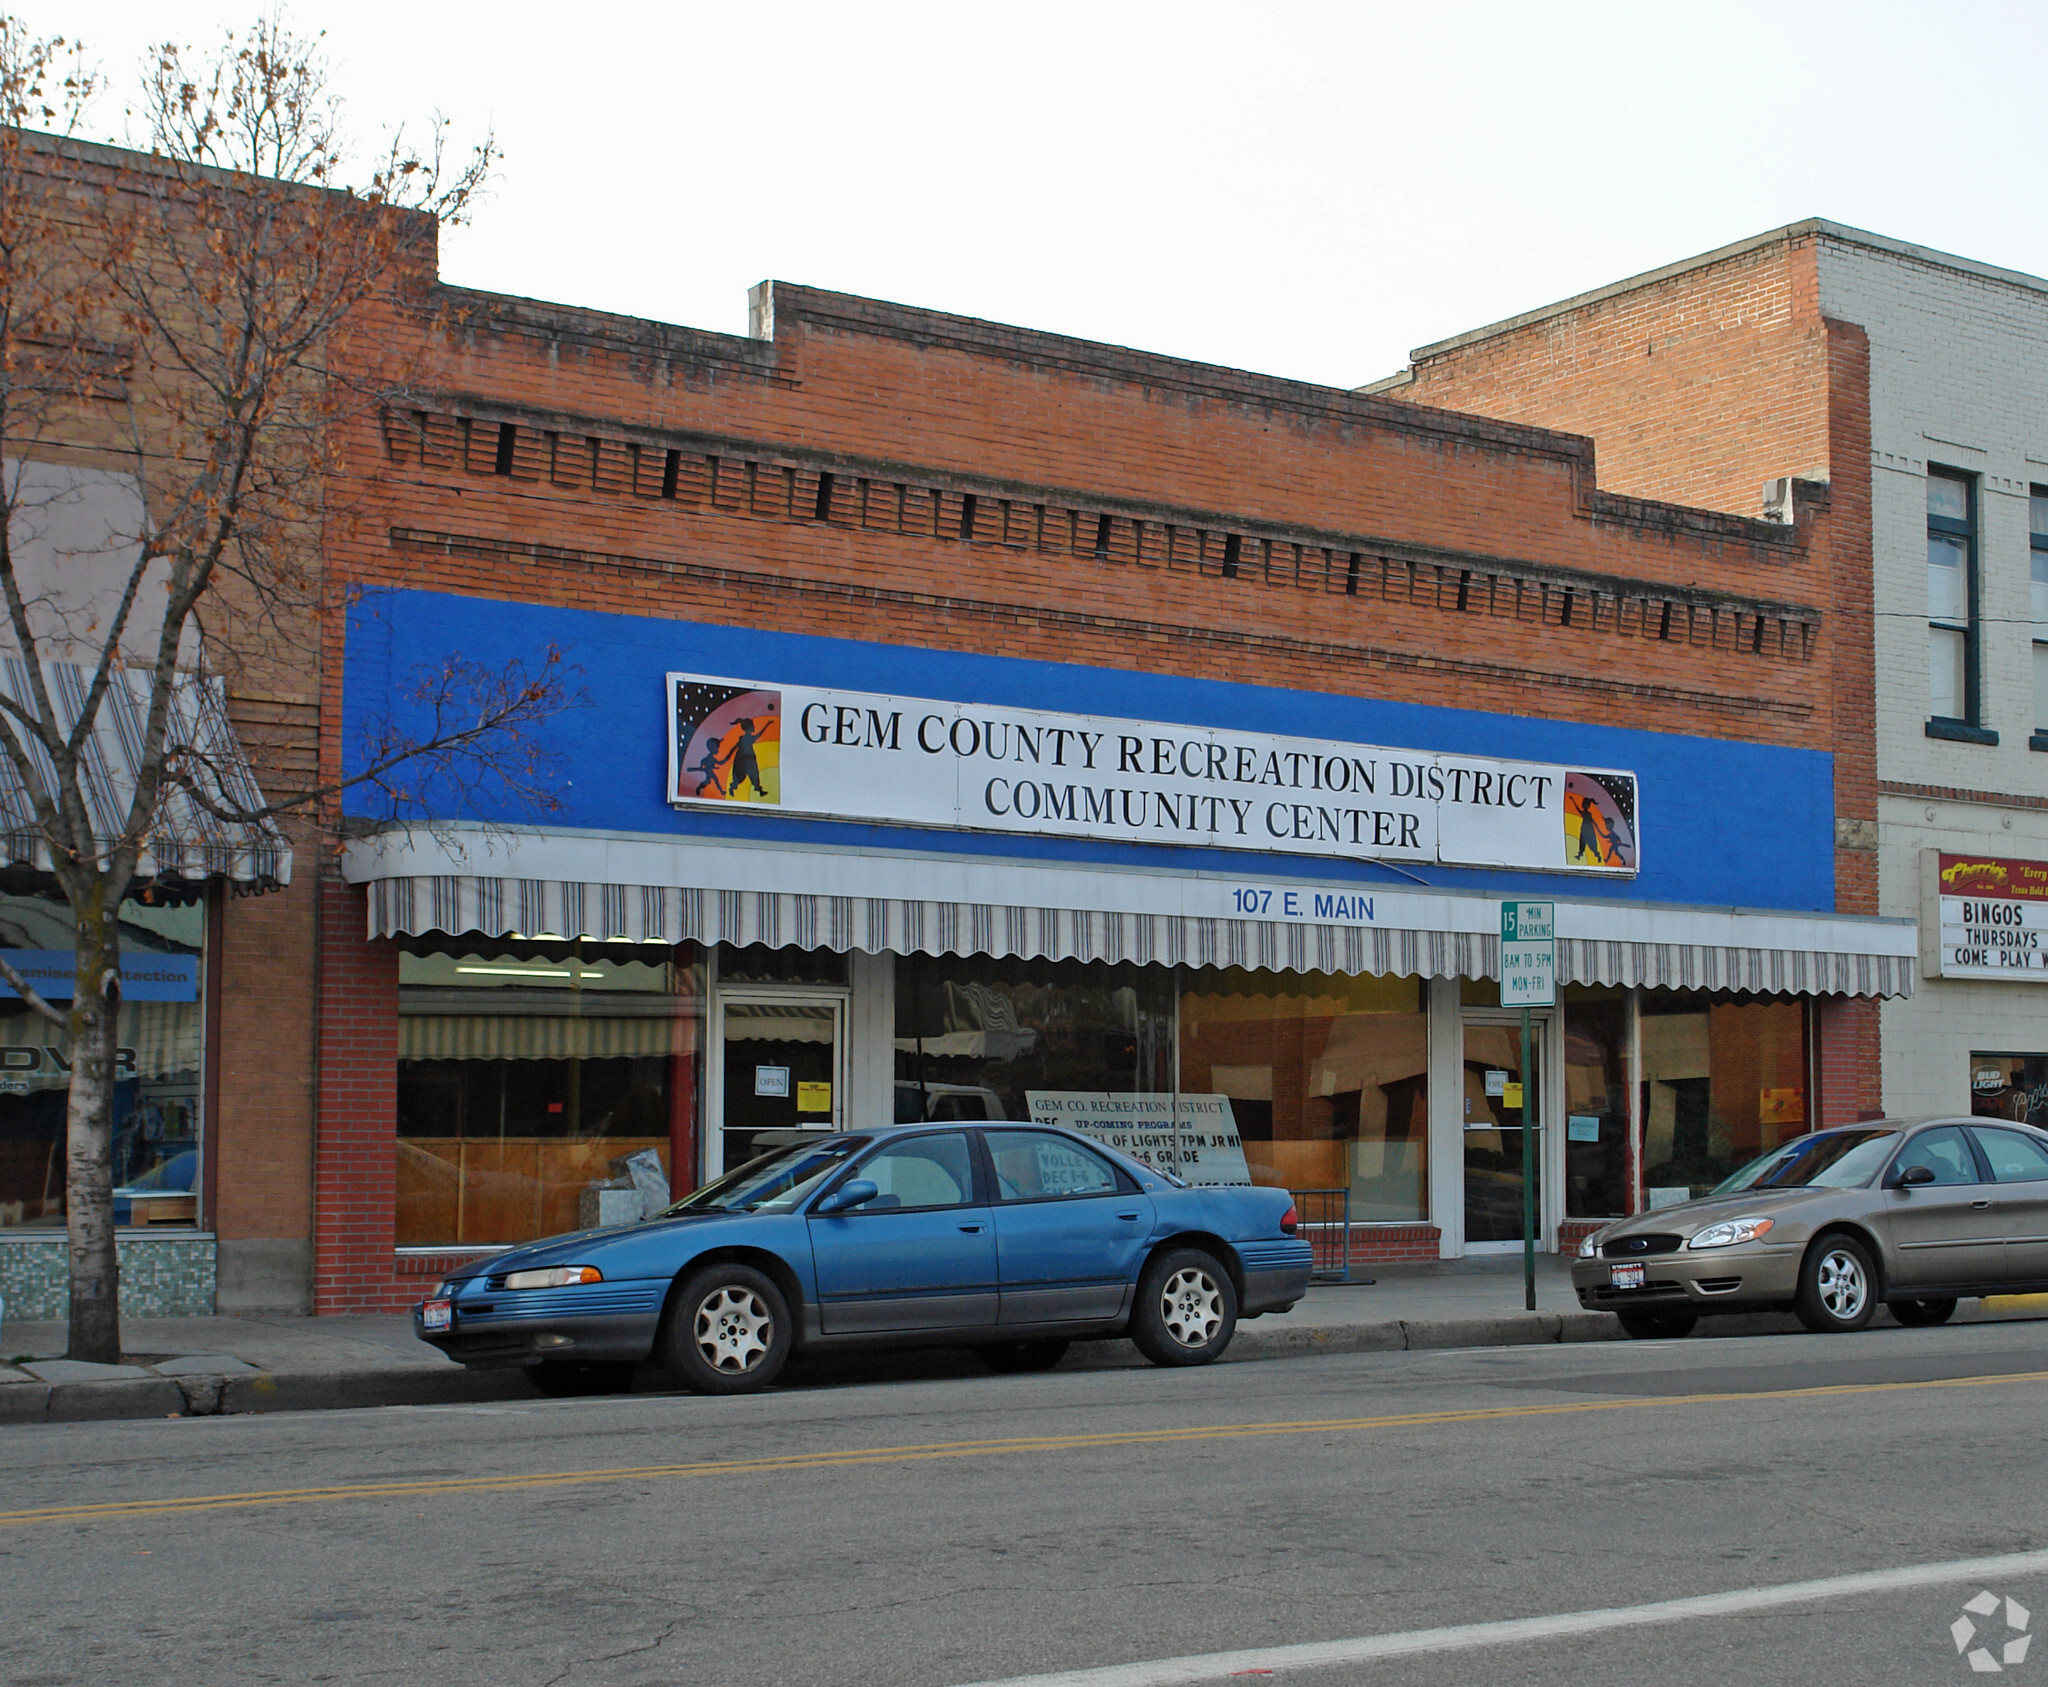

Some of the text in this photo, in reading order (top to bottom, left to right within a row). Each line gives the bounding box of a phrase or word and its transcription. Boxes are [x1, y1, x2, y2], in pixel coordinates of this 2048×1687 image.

[800, 702, 1553, 810] GEM COUNTY RECREATION DISTRICT
[984, 776, 1422, 849] COMMUNITY CENTER
[1941, 860, 2008, 887] Cherries
[1232, 888, 1375, 920] 107 E. MAIN
[1527, 906, 1542, 920] MIN
[1963, 901, 2023, 926] BINGOS
[1503, 911, 1515, 931] 15
[1519, 923, 1551, 937] PARKING
[1966, 928, 2038, 949] THURSDAYS
[1504, 953, 1551, 968] 8AM TO 5PM
[1955, 948, 1989, 966] COME
[2000, 950, 2031, 968] PLAY
[1512, 976, 1544, 991] MON-FRI
[760, 1077, 784, 1087] OPEN
[1976, 1070, 2001, 1080] BUD
[1488, 1080, 1505, 1089] OPE
[1972, 1079, 2005, 1090] LIGHT
[1035, 1099, 1063, 1112] GEM
[1067, 1100, 1088, 1112] CO.
[1091, 1100, 1166, 1113] RECREATION
[1075, 1120, 1134, 1129] UP-COMING
[1112, 1134, 1128, 1147] OF
[1131, 1134, 1175, 1147] LIGHTS
[1179, 1134, 1206, 1148] 7PM
[1210, 1135, 1226, 1148] JR
[1227, 1134, 1241, 1148] HI
[1042, 1170, 1067, 1184] DEC
